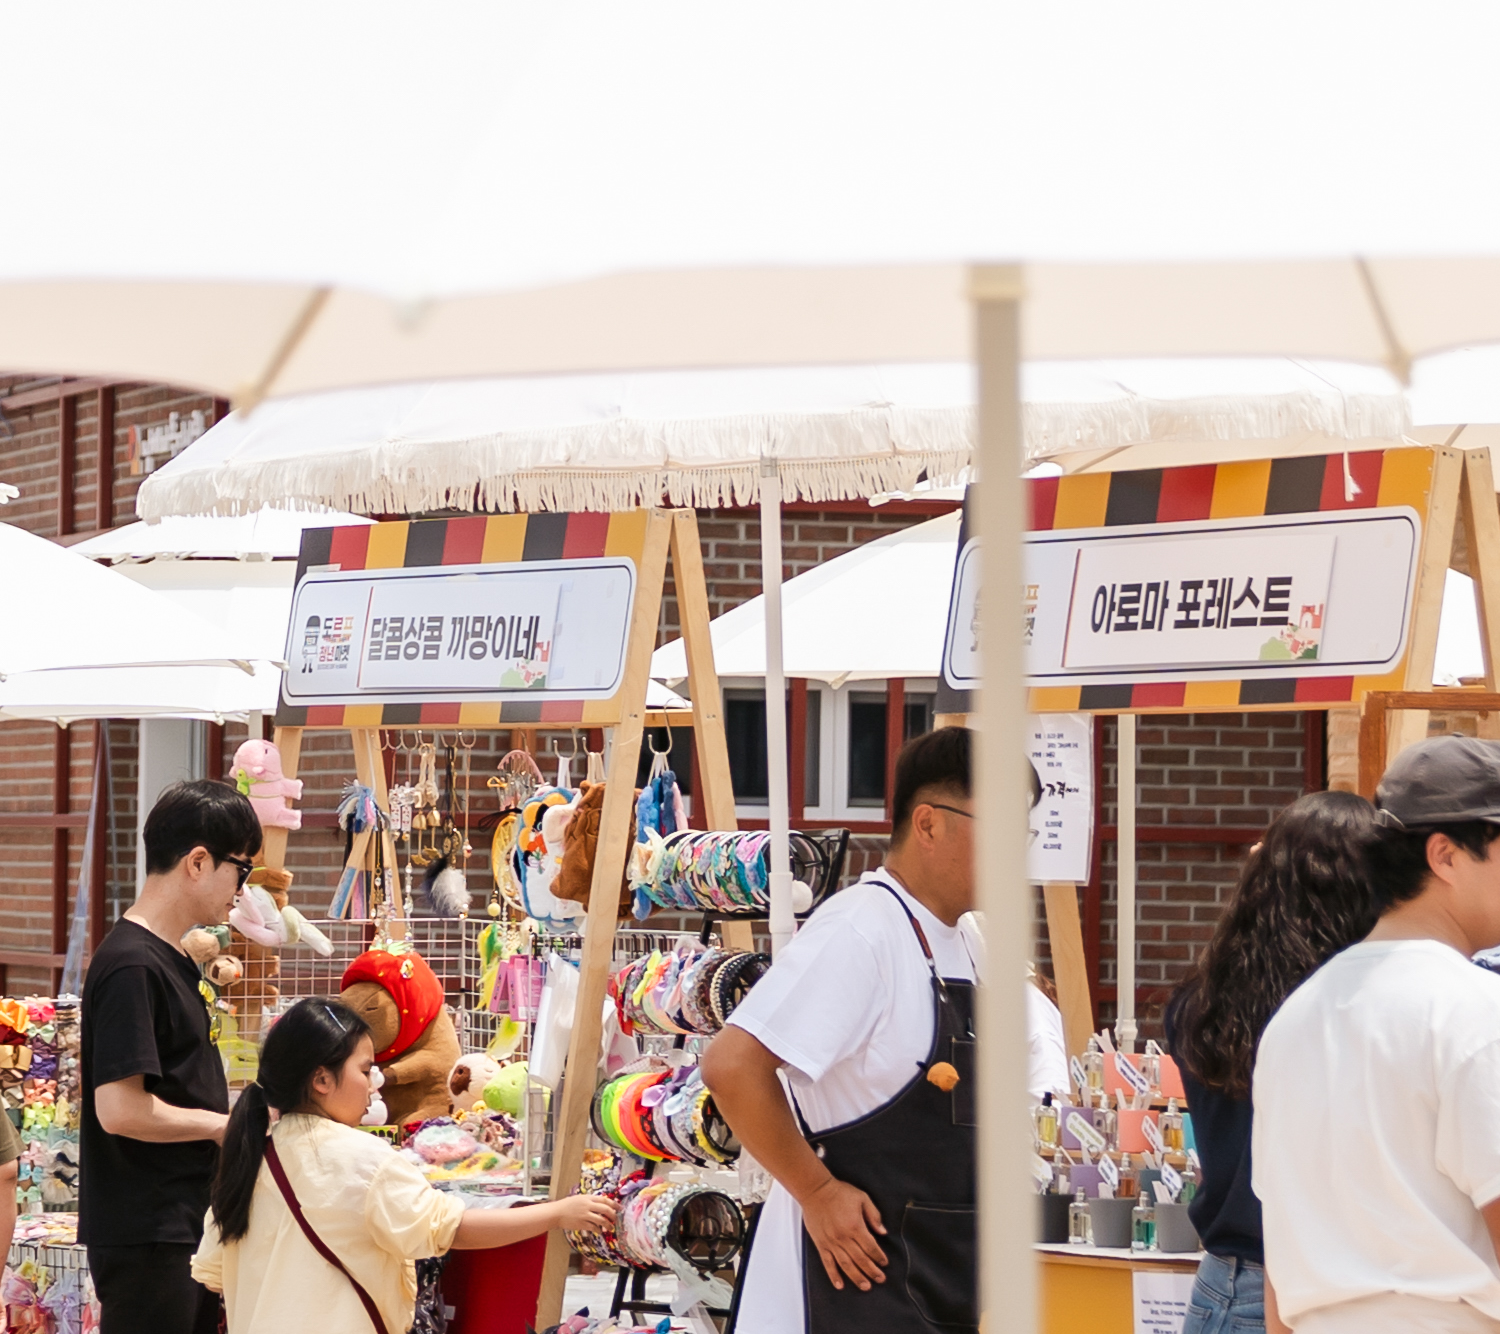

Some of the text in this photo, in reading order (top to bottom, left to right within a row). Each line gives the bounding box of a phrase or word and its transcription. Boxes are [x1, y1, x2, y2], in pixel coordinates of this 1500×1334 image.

[1091, 580, 1170, 634] 아로마
[1173, 576, 1293, 629] 포레스트
[367, 616, 540, 661] 달콤상콤 까망이네
